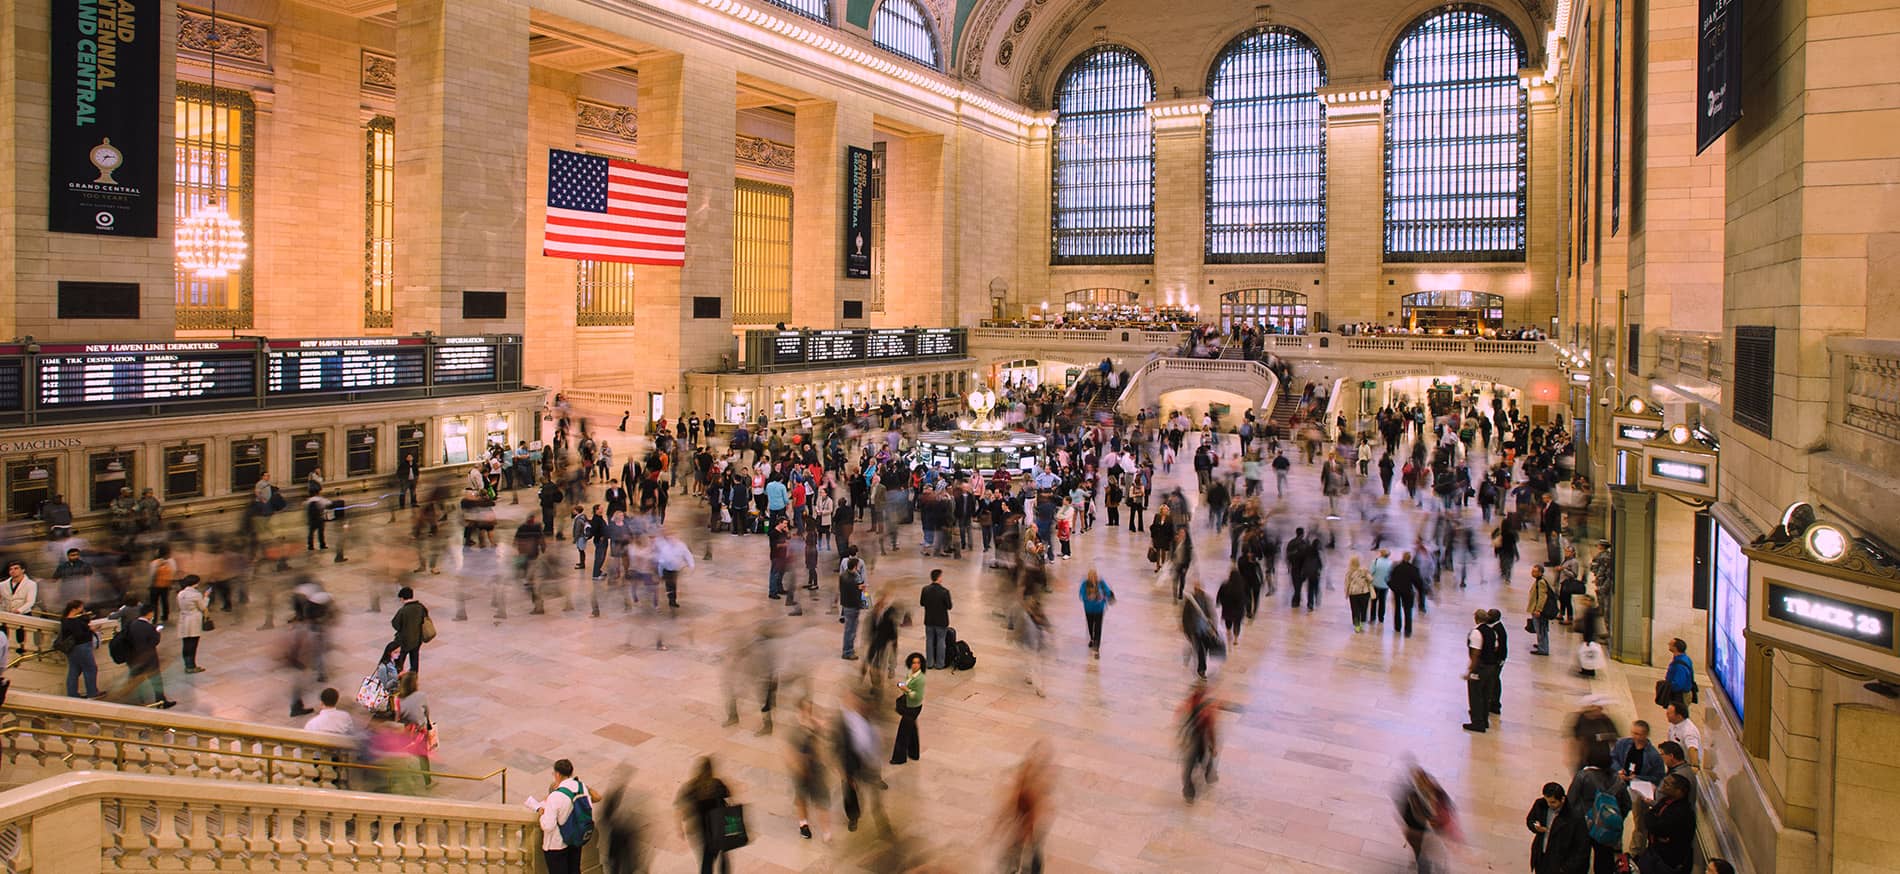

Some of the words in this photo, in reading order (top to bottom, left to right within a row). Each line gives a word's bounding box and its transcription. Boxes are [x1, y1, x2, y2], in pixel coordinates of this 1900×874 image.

[76, 39, 97, 127] CENTRAL
[69, 182, 100, 190] GRAND
[102, 185, 141, 194] CENTRAL
[111, 344, 143, 352] HAVEN
[144, 343, 165, 351] LINE
[167, 342, 219, 350] DEPARTURES
[14, 437, 81, 451] MACHINES
[1783, 596, 1855, 629] TRACK
